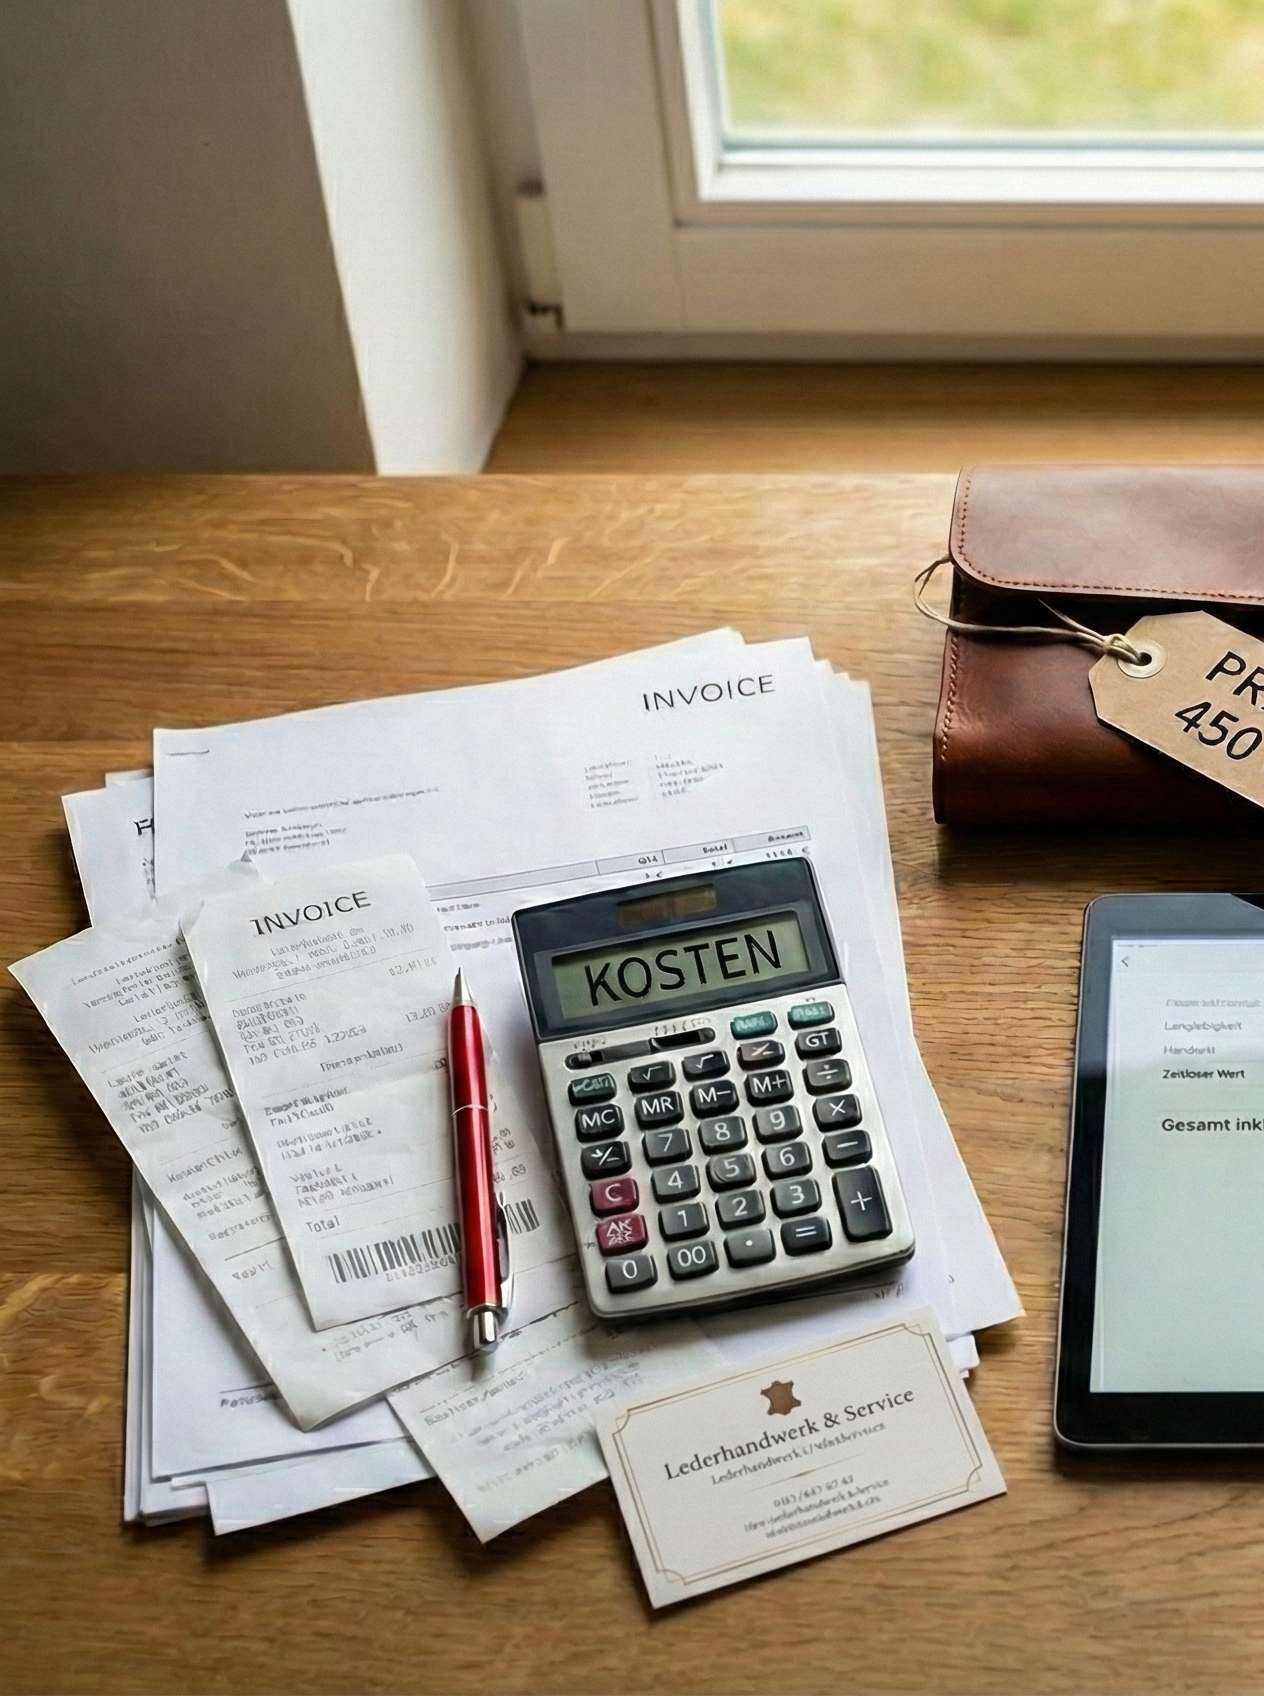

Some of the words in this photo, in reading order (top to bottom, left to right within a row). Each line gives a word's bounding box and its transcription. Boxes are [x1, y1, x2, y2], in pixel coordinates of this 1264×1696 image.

[642, 674, 775, 712] INVOICE
[1174, 701, 1263, 760] 450
[251, 890, 372, 936] INVOICE
[584, 930, 782, 1007] KOSTEN
[805, 1031, 829, 1048] GT
[752, 1074, 788, 1094] M+
[641, 1096, 674, 1116] MR
[581, 1109, 616, 1129] MC
[769, 1110, 786, 1131] 9
[1161, 1118, 1231, 1132] Gesamt
[714, 1122, 731, 1141] 8
[657, 1132, 673, 1152] 7
[779, 1146, 795, 1166] 6
[723, 1157, 740, 1178] 5
[667, 1170, 684, 1189] 4
[604, 1183, 623, 1202] C
[789, 1185, 805, 1204] 3
[732, 1197, 748, 1217] 2
[306, 1215, 340, 1234] Total
[677, 1209, 688, 1227] 1
[677, 1245, 707, 1267] 00
[622, 1259, 638, 1279] 0
[663, 1417, 821, 1481] Lederhandwerk
[823, 1411, 842, 1429] &
[842, 1389, 915, 1422] Service
